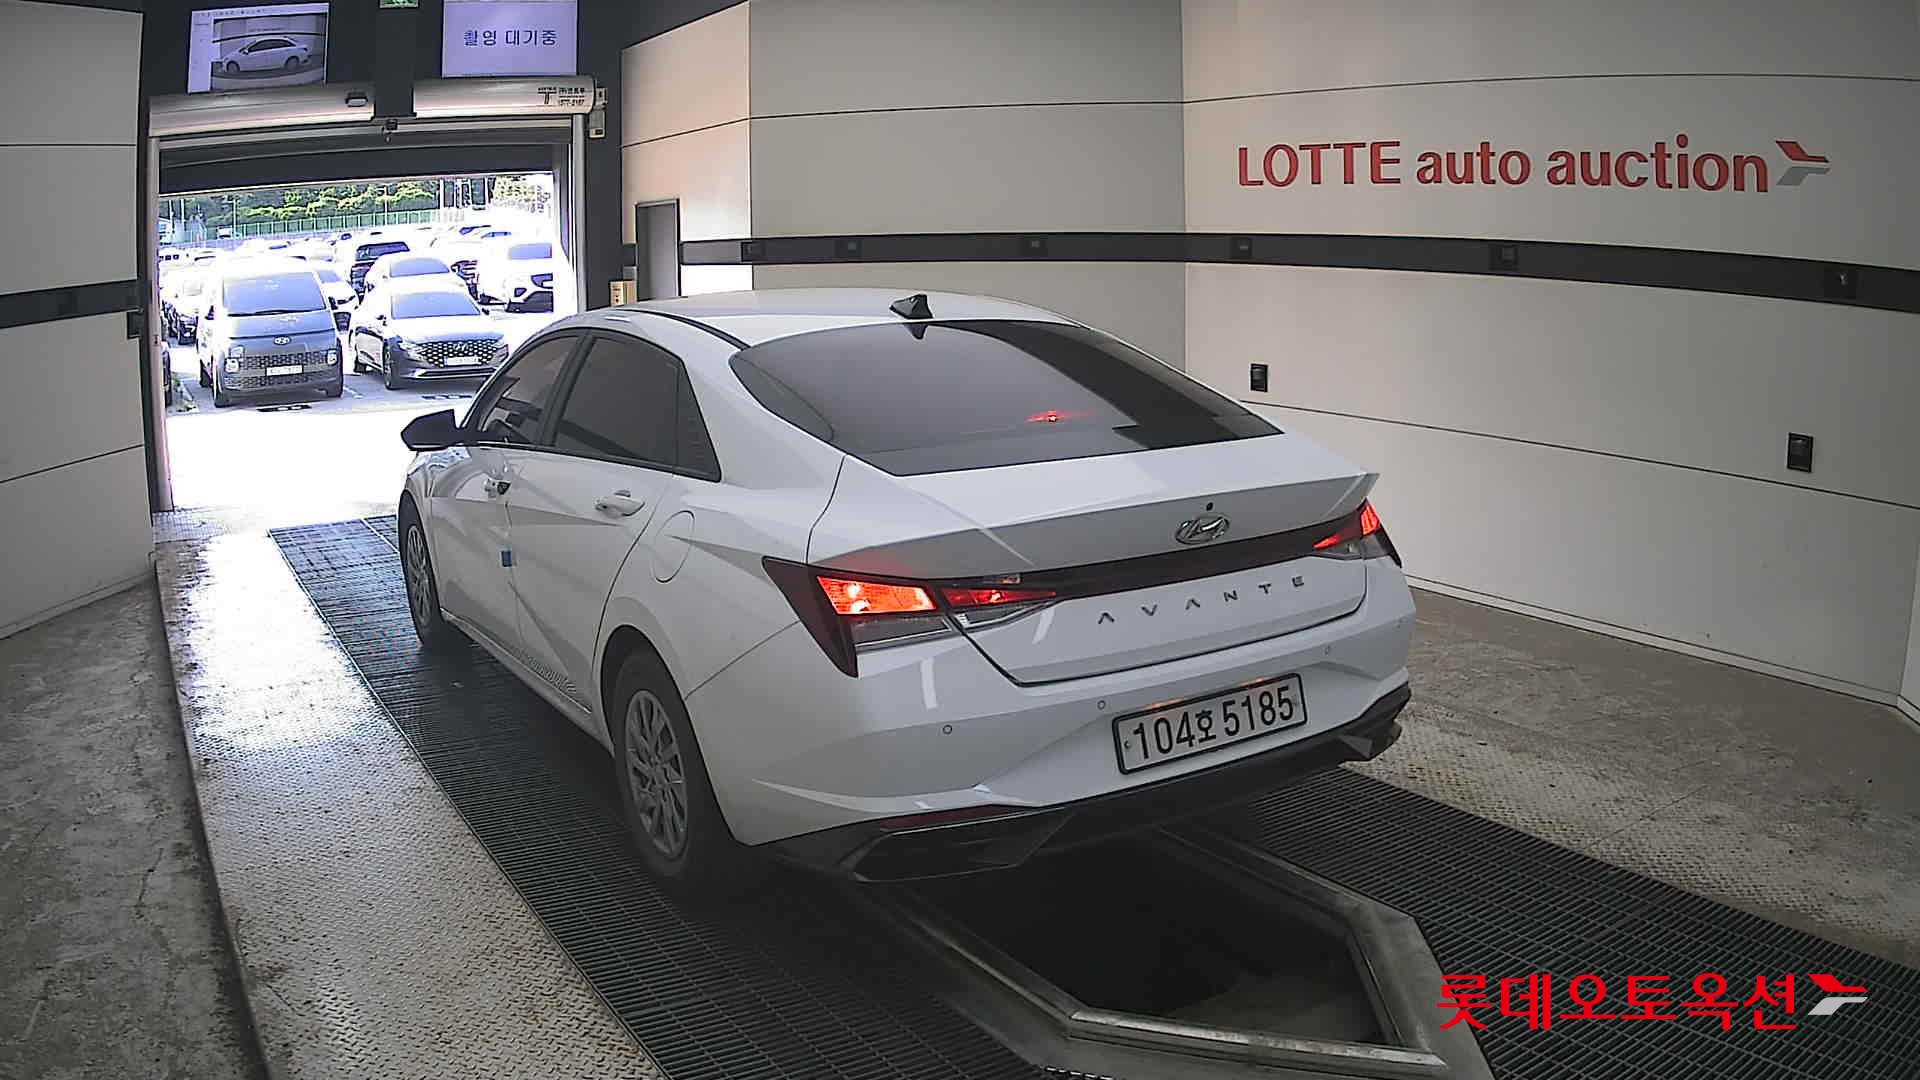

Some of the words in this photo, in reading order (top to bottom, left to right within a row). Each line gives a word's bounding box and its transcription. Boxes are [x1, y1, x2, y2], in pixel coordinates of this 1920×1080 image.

[505, 29, 558, 47] 대기중
[1238, 140, 1401, 188] LOTTE
[1416, 141, 1531, 185] auto
[1547, 134, 1769, 193] auction
[1098, 575, 1305, 625] AVANTE
